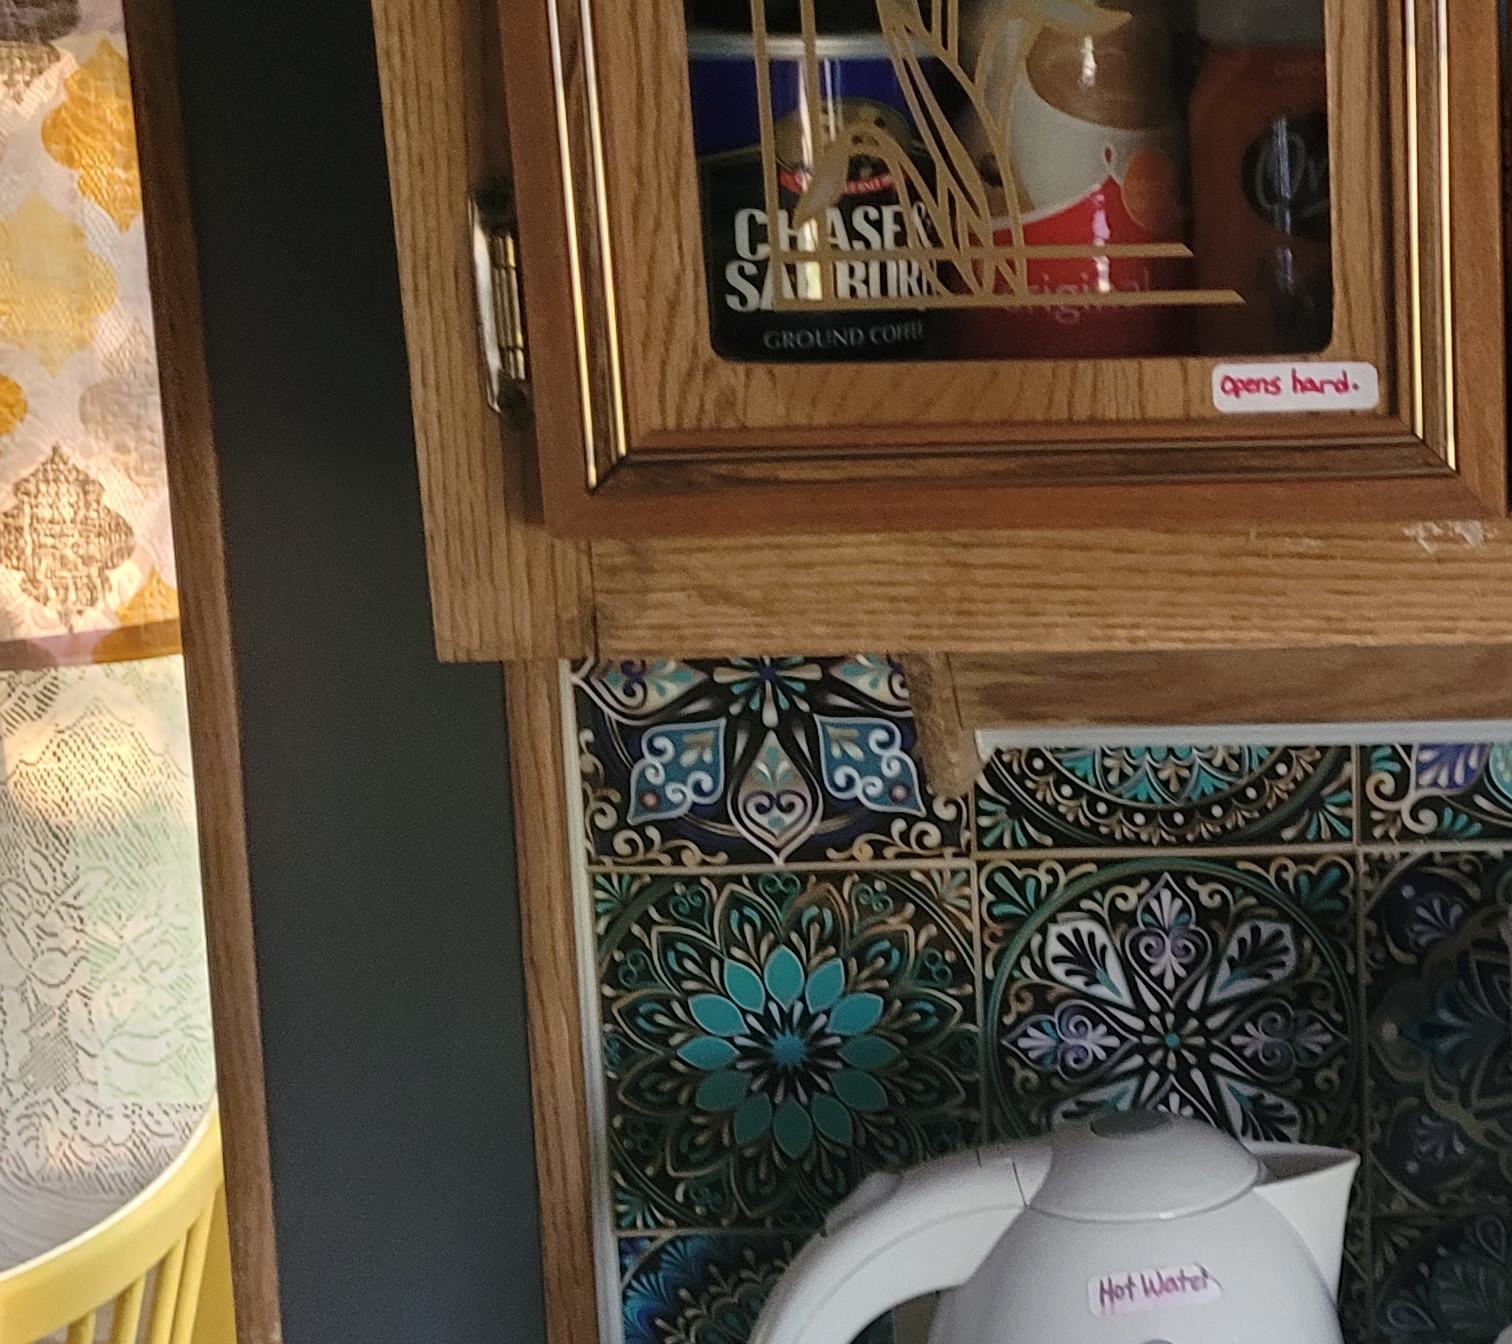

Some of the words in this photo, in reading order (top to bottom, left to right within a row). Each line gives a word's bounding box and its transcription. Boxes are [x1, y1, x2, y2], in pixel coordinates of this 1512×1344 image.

[1003, 267, 1149, 325] rigial
[763, 328, 864, 349] GROUND
[1099, 1275, 1137, 1307] Hot
